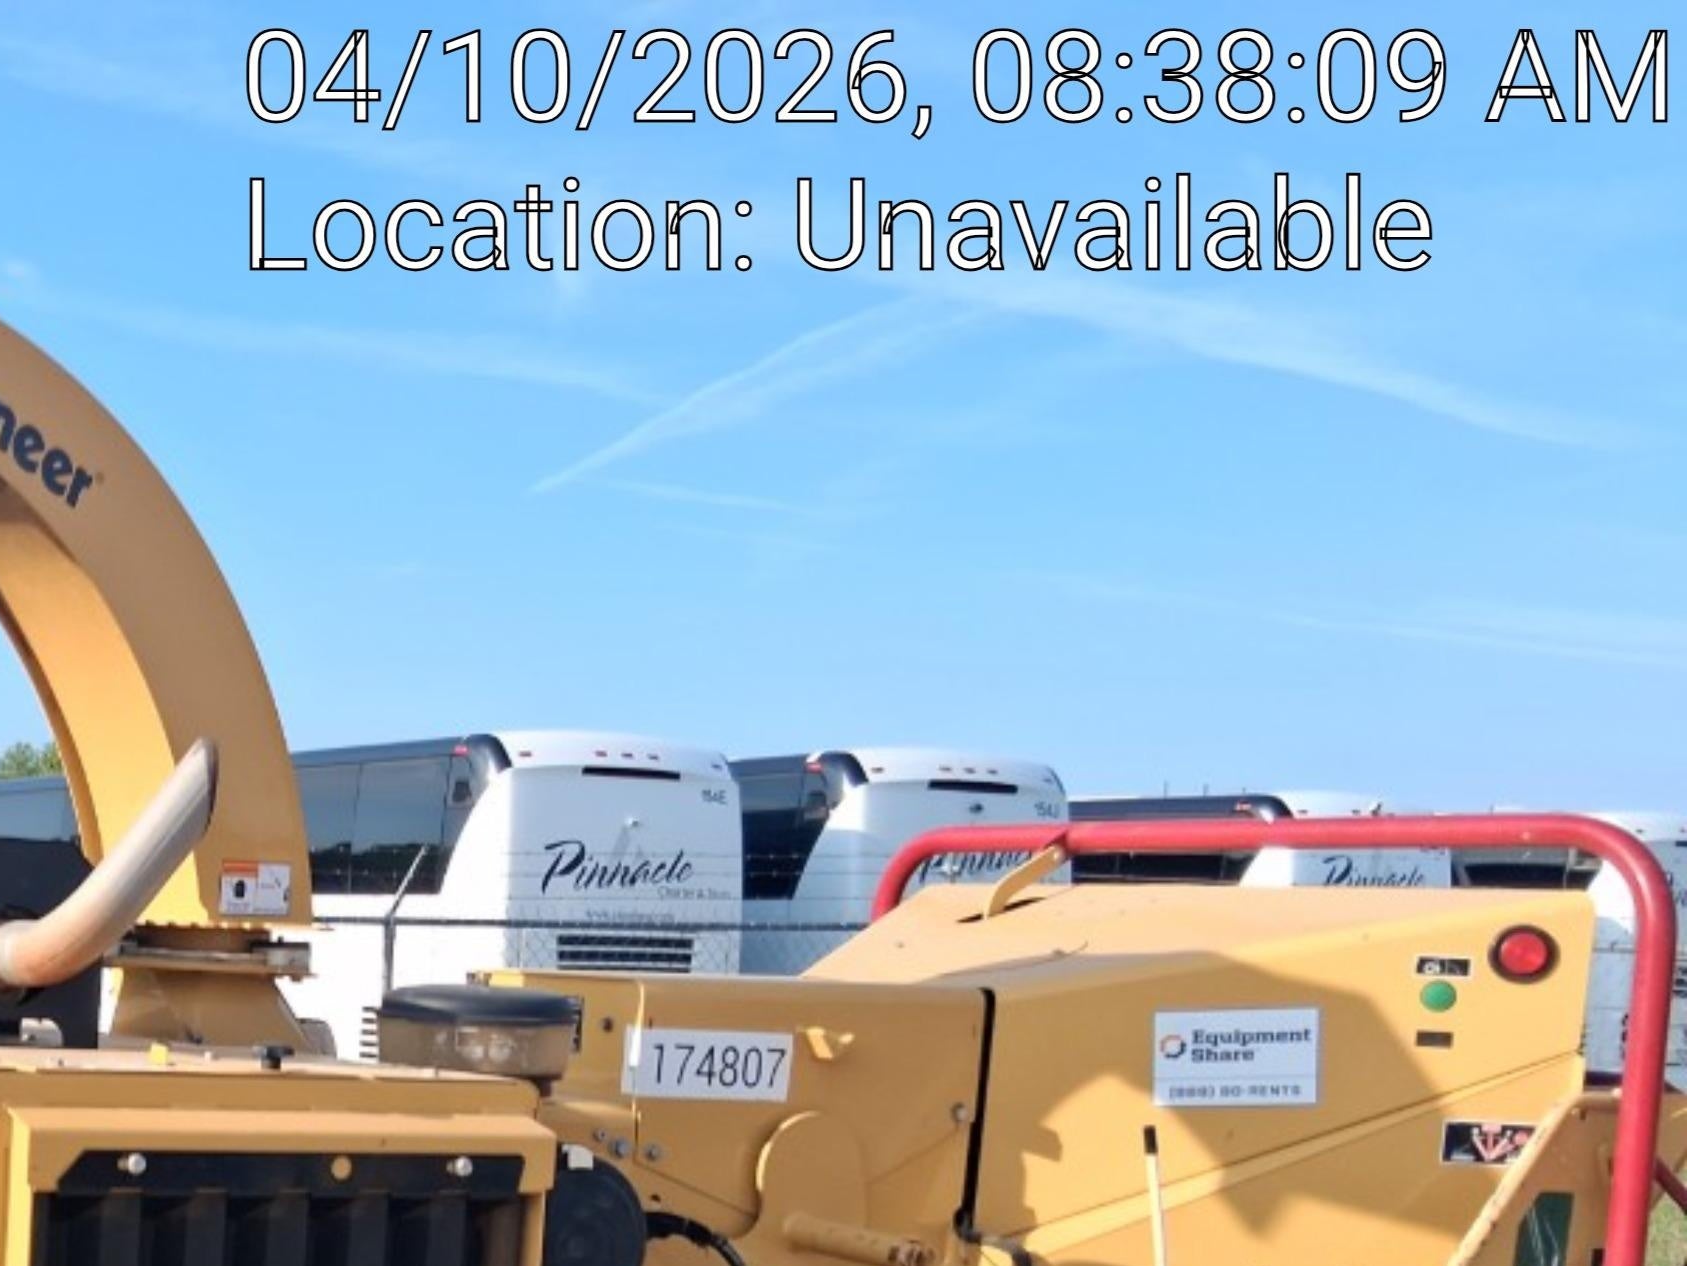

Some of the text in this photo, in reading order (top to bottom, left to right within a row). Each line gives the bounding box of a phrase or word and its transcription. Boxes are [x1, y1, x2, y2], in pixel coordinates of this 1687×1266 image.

[541, 840, 694, 894] Pinnacle
[1191, 1028, 1311, 1047] Equipment
[652, 1040, 787, 1090] 174807
[1191, 1048, 1255, 1063] Share
